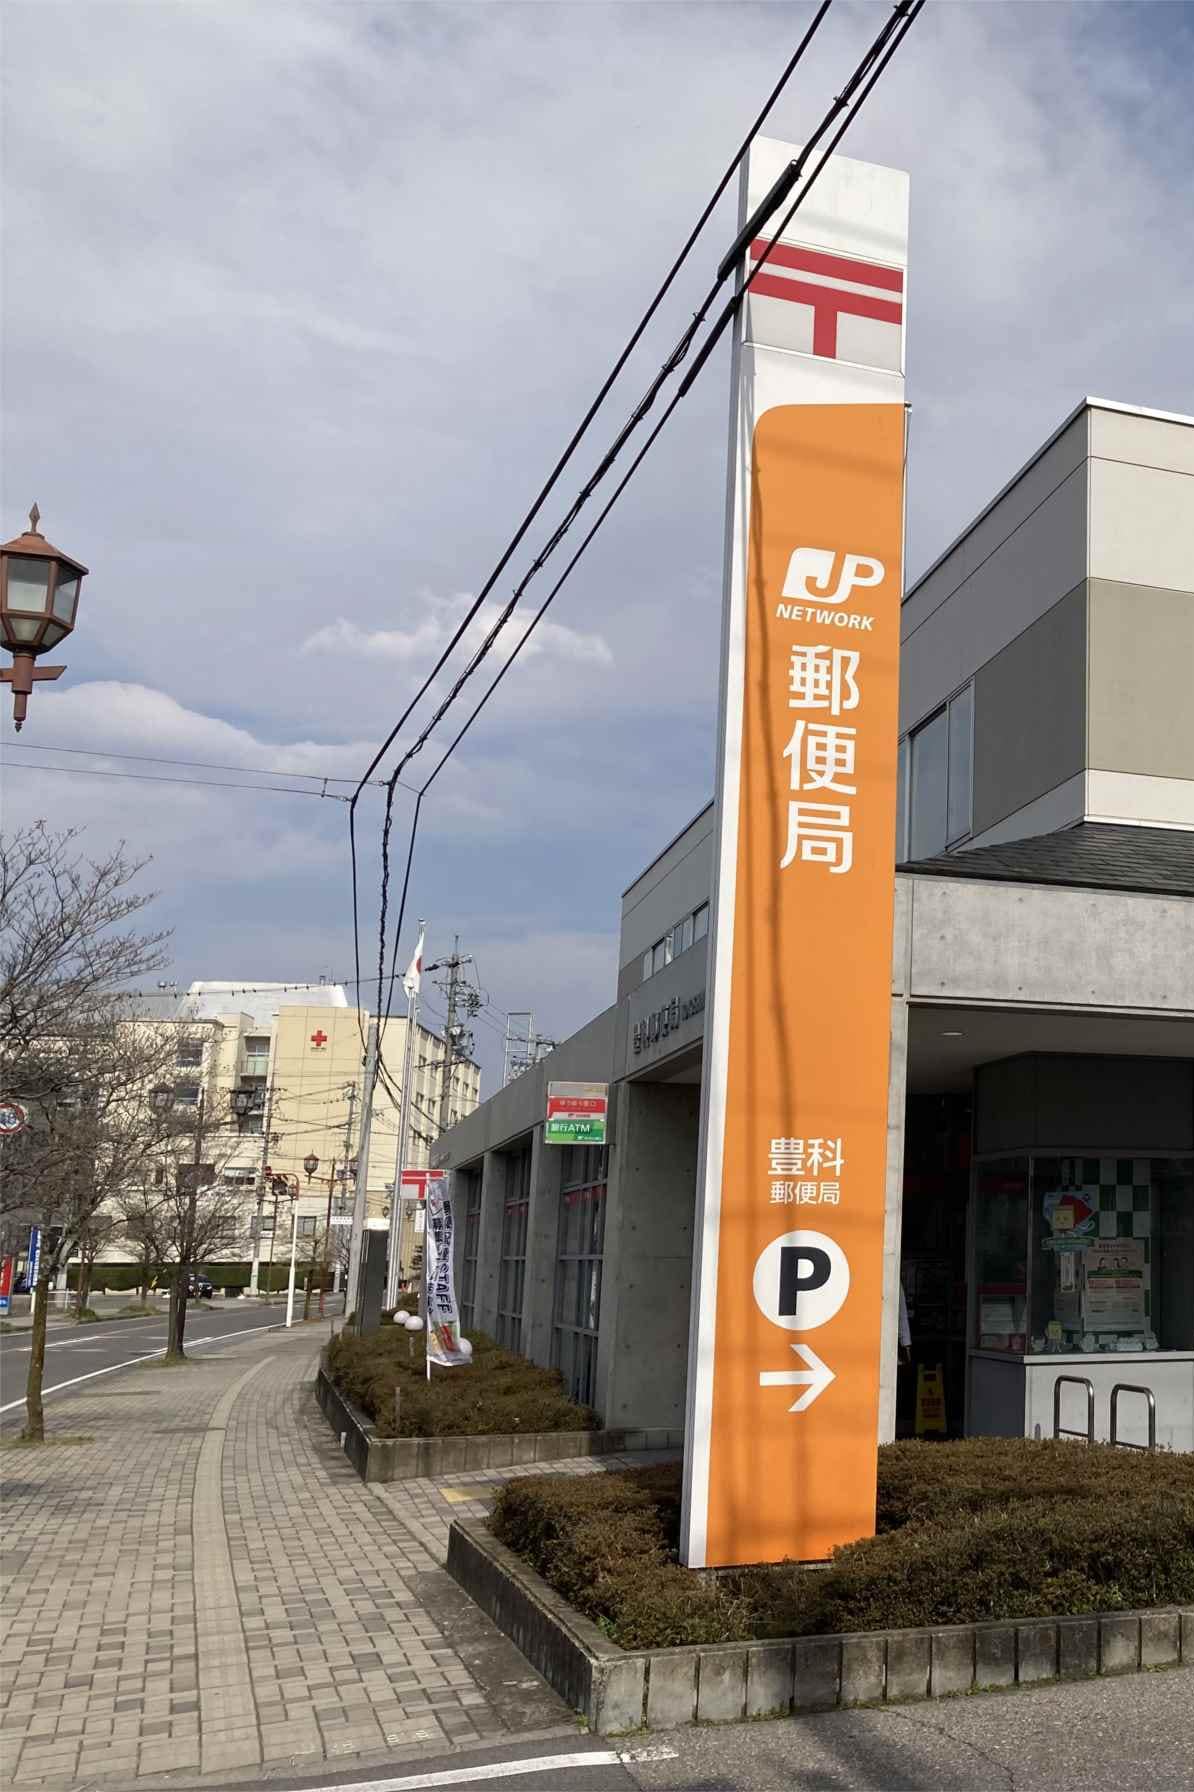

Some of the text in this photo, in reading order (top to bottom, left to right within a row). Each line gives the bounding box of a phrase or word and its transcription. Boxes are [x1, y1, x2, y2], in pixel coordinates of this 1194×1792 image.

[781, 547, 885, 604] JP
[776, 603, 875, 631] NETWORK
[780, 644, 860, 874] 郵便局
[767, 1137, 845, 1177] 豊科
[769, 1180, 840, 1205] 郵便局
[778, 1246, 832, 1316] P
